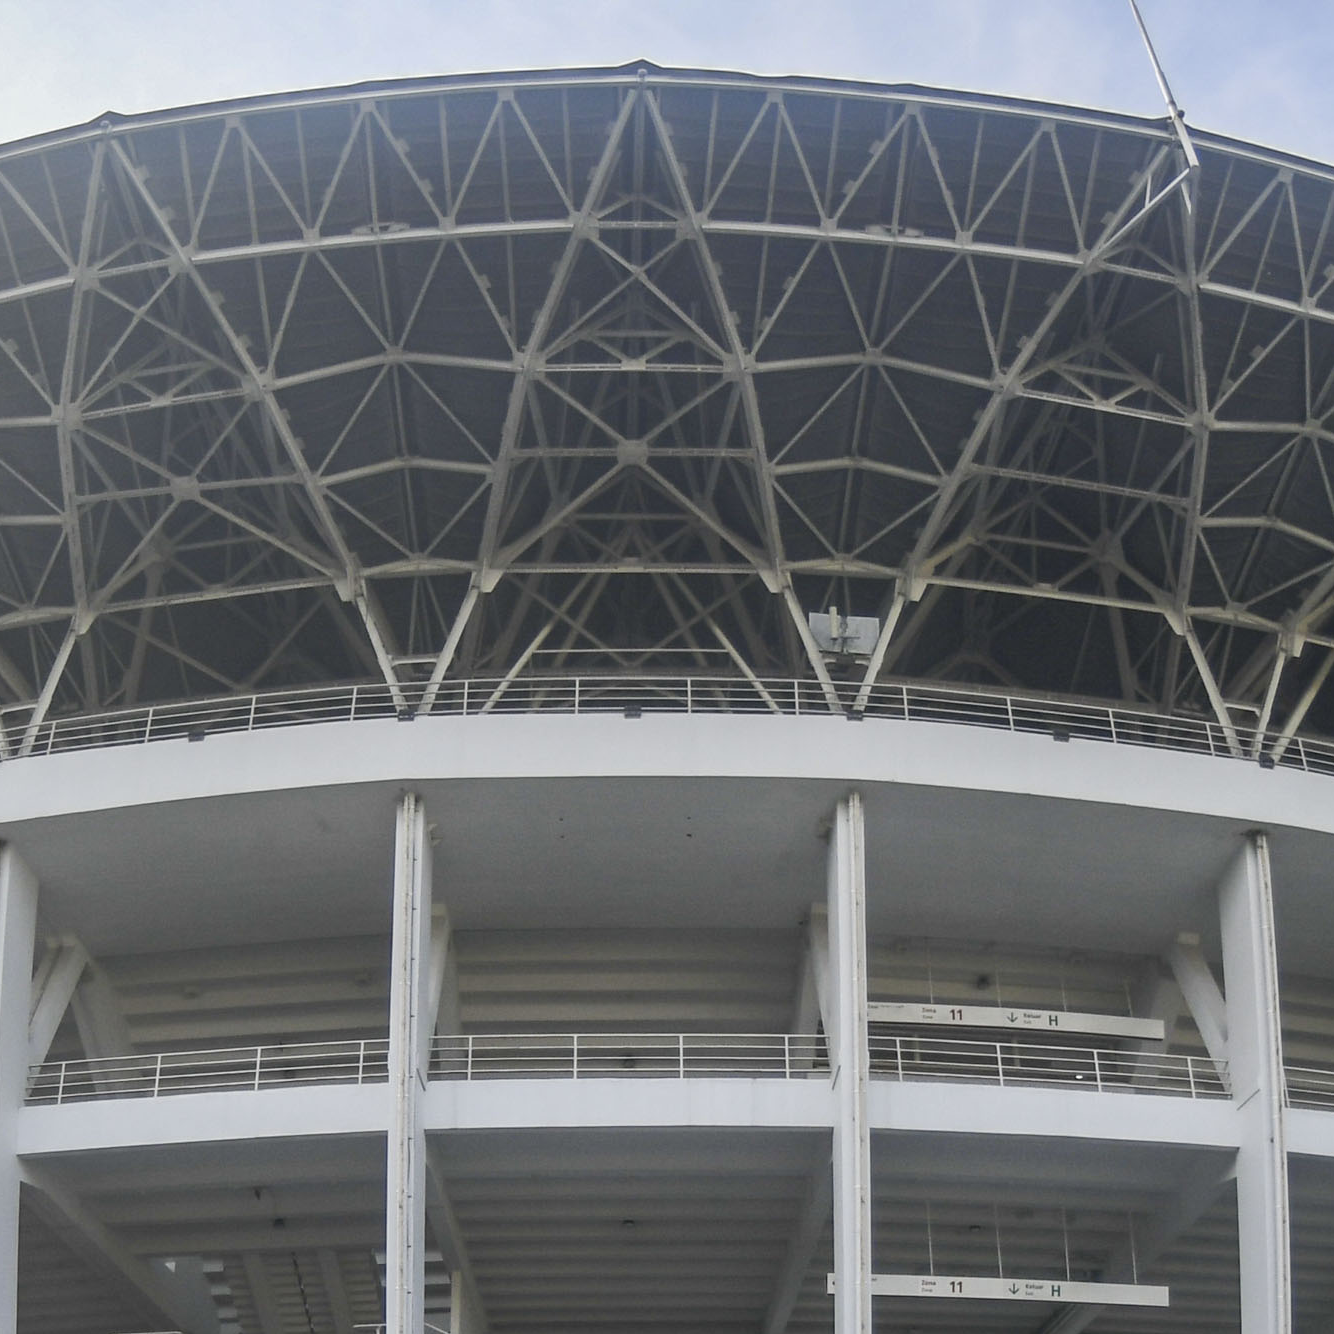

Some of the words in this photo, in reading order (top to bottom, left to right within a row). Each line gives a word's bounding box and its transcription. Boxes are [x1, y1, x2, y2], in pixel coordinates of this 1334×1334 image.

[949, 1009, 963, 1021] 11
[1048, 1014, 1059, 1027] H
[949, 1280, 963, 1294] 11
[1051, 1284, 1062, 1297] H
